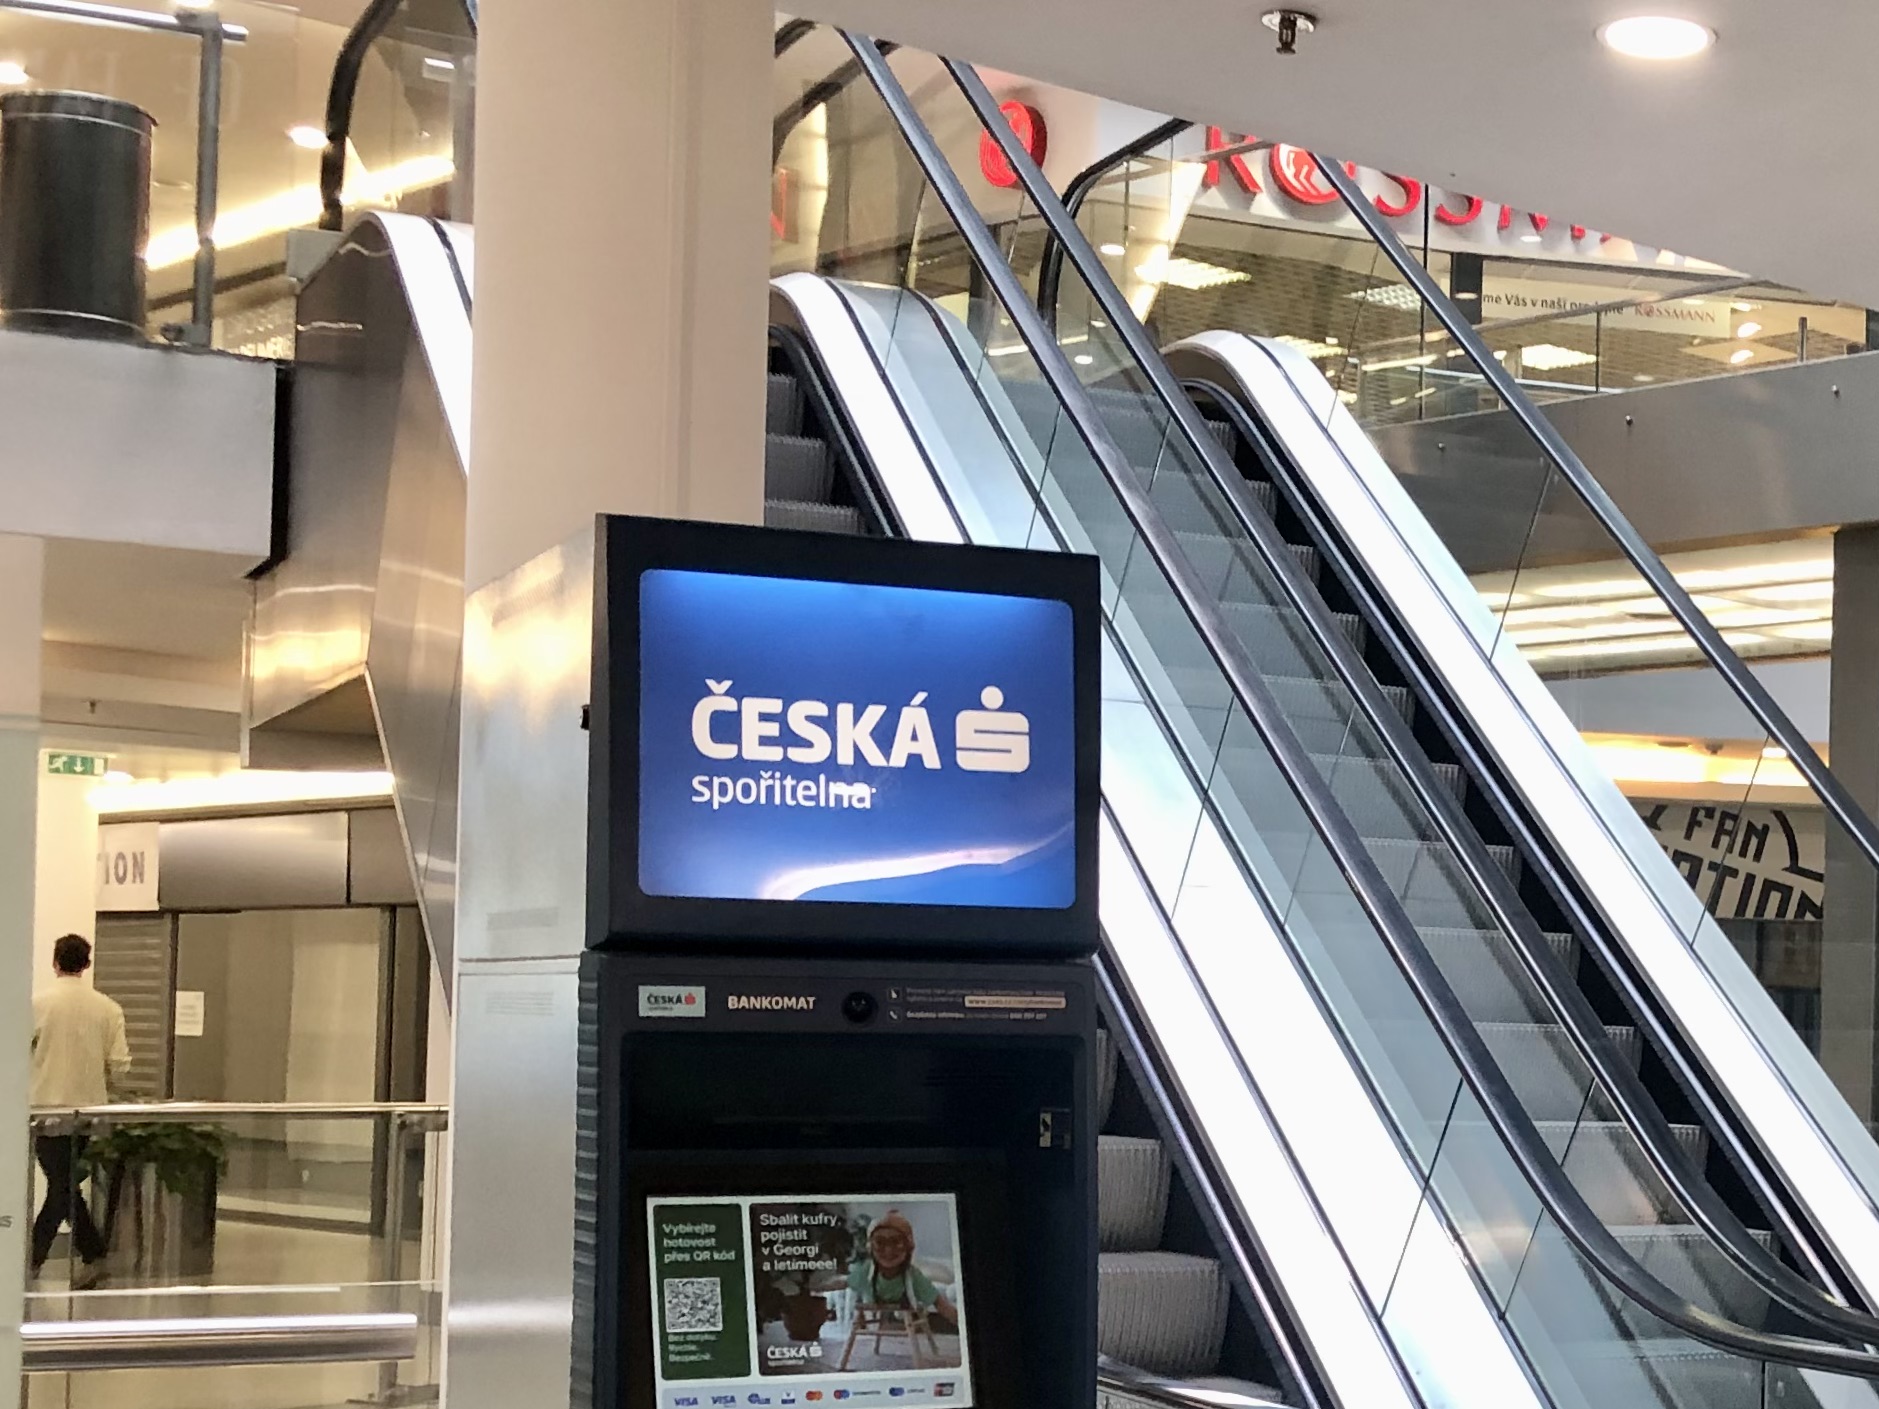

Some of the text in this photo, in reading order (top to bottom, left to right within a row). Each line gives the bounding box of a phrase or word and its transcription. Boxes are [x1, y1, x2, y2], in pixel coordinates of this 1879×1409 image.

[1483, 294, 1502, 305] me
[1505, 293, 1527, 307] Vás
[1531, 299, 1539, 308] v
[692, 678, 942, 770] ČESKÁ
[691, 770, 872, 811] spořitelna
[1683, 806, 1770, 863] FAN
[97, 850, 146, 886] ION
[647, 992, 683, 1005] ČESKÁ
[727, 995, 816, 1010] BANKOMAT
[760, 1213, 799, 1226] Sbalit
[663, 1237, 716, 1248] hotovost
[761, 1228, 807, 1244] pojistit
[693, 1250, 711, 1261] QR
[713, 1249, 735, 1261] kód
[761, 1243, 819, 1257] v Georgi
[763, 1261, 771, 1271] a
[767, 1345, 808, 1359] ČESKÁ
